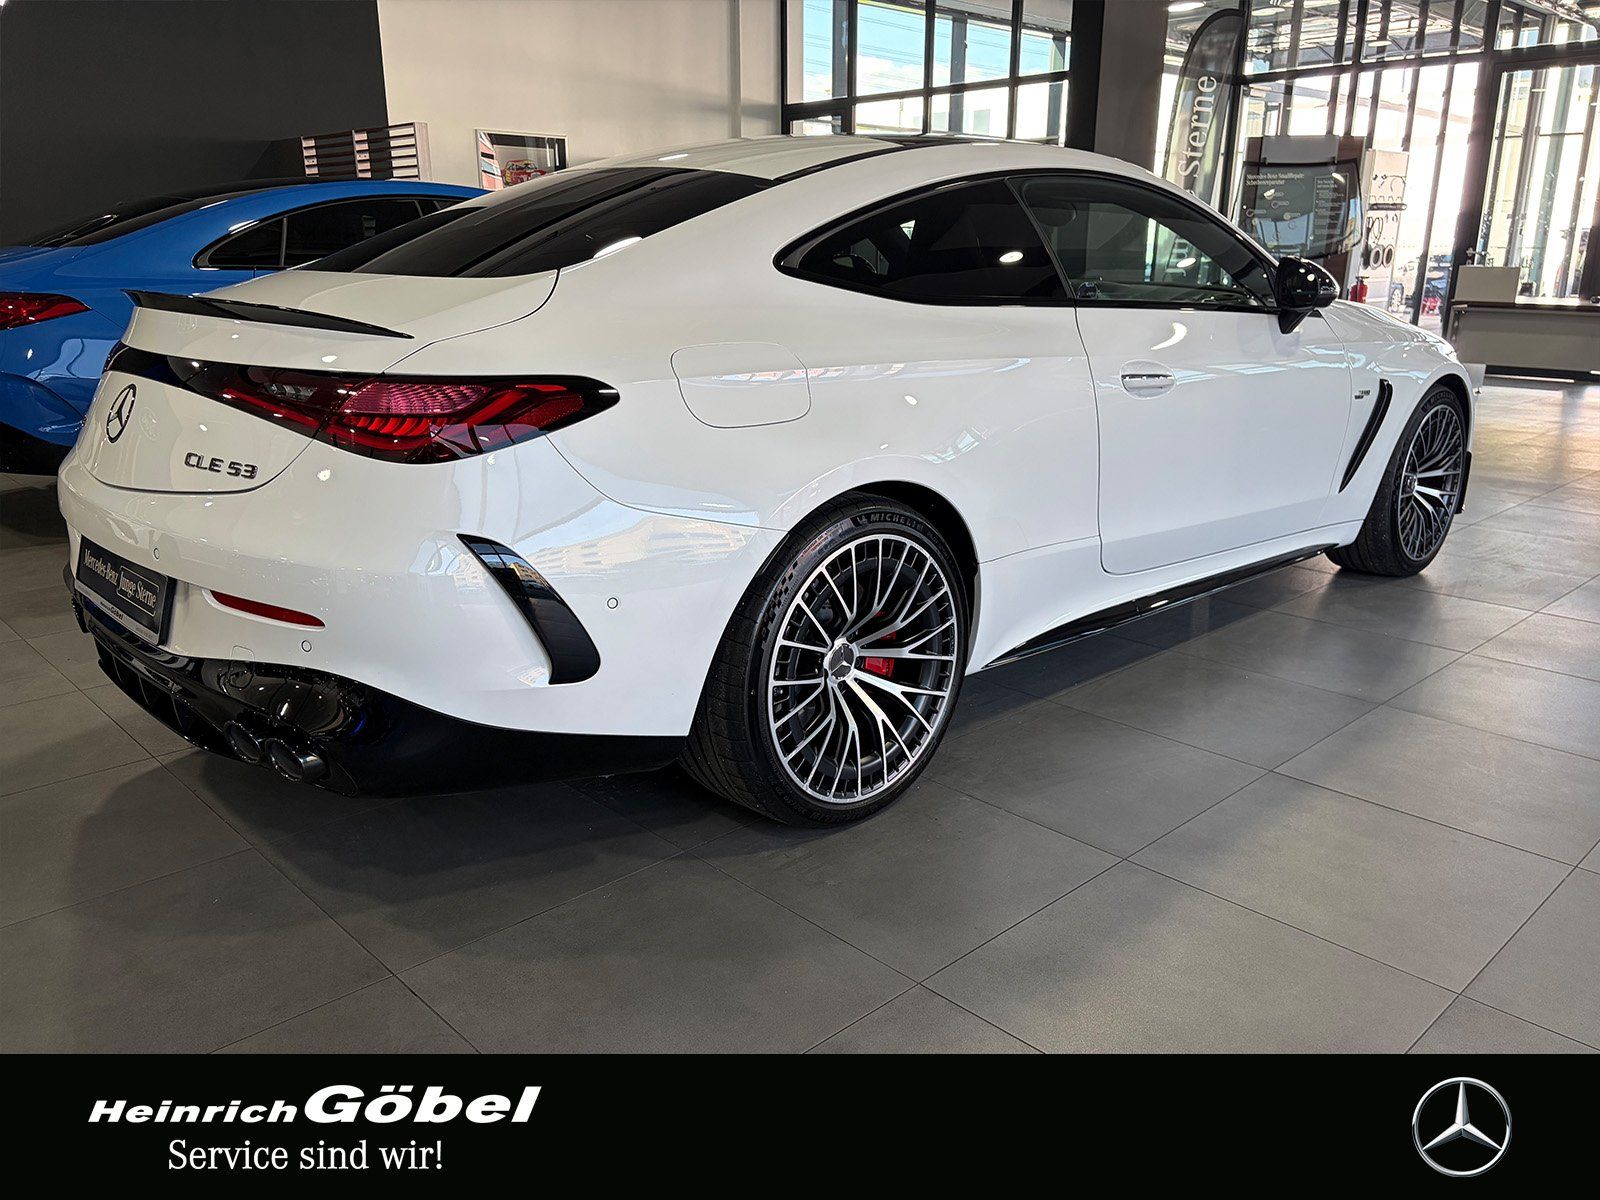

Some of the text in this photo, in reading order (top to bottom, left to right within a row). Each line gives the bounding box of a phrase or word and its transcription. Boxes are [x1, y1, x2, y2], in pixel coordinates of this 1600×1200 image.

[1177, 75, 1218, 178] Sterne
[184, 452, 259, 480] CLE 53
[870, 512, 924, 531] MICHELIN
[84, 548, 119, 586] Mercedes-Benz
[119, 571, 157, 609] Junge Sterne
